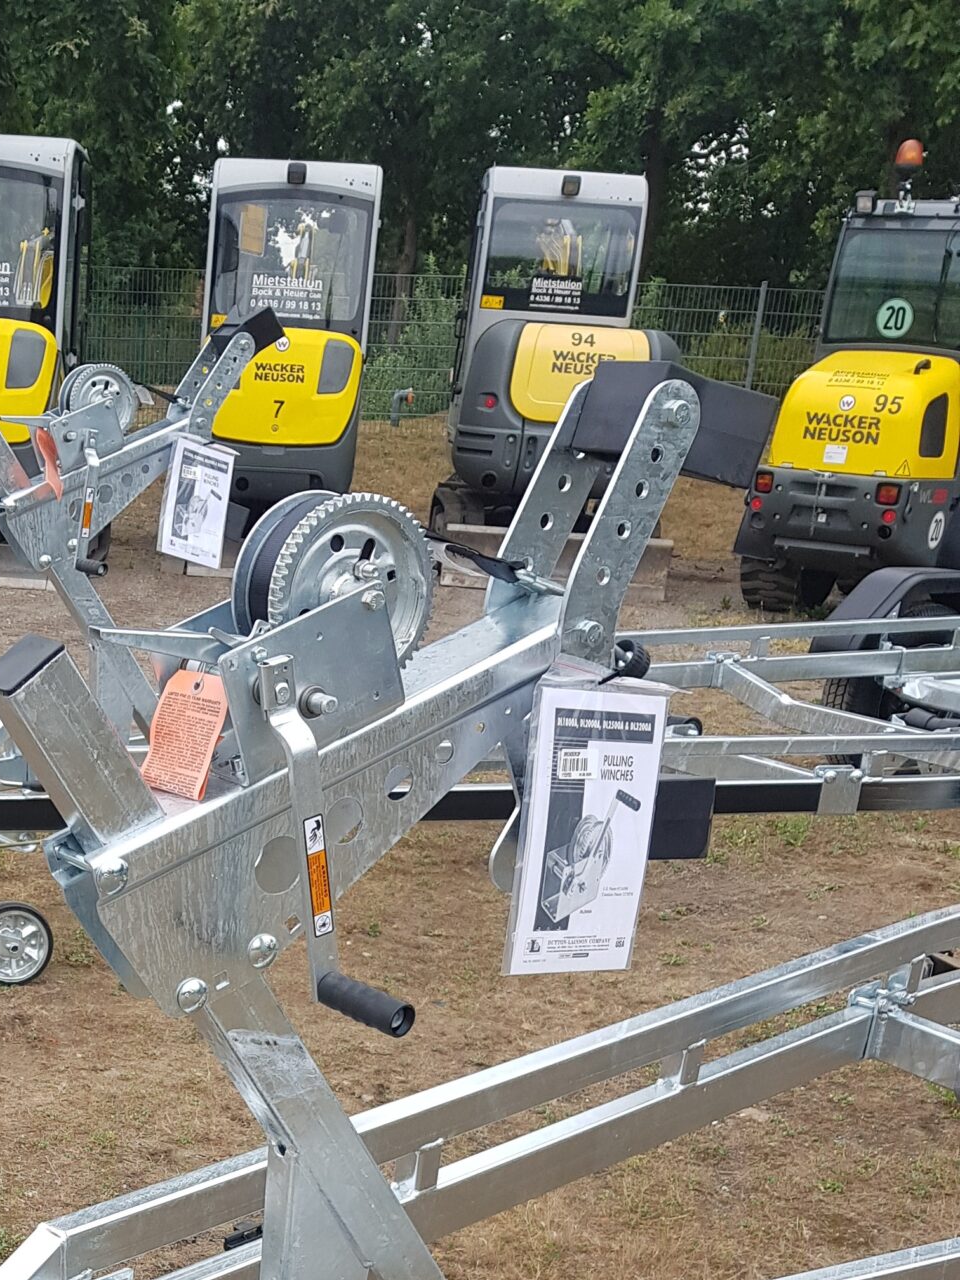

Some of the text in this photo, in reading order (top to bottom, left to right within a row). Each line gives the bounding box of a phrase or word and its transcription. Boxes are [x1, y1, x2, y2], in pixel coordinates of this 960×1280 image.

[252, 274, 323, 289] Mietstation
[532, 277, 582, 289] Mietstation
[0, 286, 10, 296] 13
[252, 287, 273, 296] Bock
[283, 289, 308, 298] Heuer
[250, 299, 256, 307] 0
[285, 300, 296, 309] 99
[299, 301, 308, 310] 18
[311, 302, 321, 311] 13
[883, 306, 906, 330] 20
[571, 332, 596, 347] 94
[254, 362, 305, 374] WACKER
[551, 362, 593, 375] NEUS
[254, 371, 305, 383] NEUSON
[273, 400, 285, 418] 7
[873, 394, 905, 414] 95
[806, 411, 881, 430] WACKER
[802, 426, 880, 445] NEUSON
[930, 518, 943, 542] 20
[603, 754, 634, 767] PULLING
[600, 769, 634, 781] WINCHES
